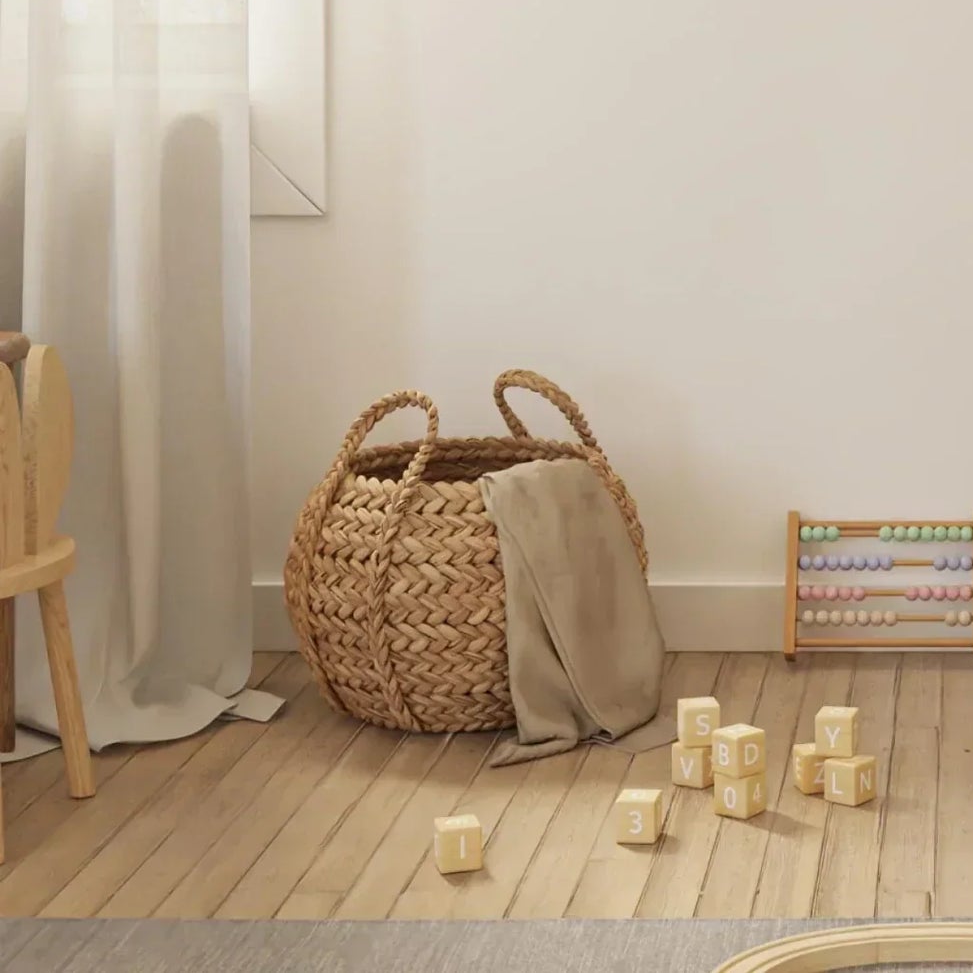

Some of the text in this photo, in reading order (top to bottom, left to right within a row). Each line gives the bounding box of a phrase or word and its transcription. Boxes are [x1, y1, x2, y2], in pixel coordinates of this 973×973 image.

[696, 714, 710, 736] S
[824, 726, 841, 749] Y
[719, 743, 729, 766] B
[745, 743, 758, 765] D
[680, 756, 694, 780] V
[831, 771, 843, 794] L
[860, 769, 871, 793] N
[628, 811, 643, 834] 3
